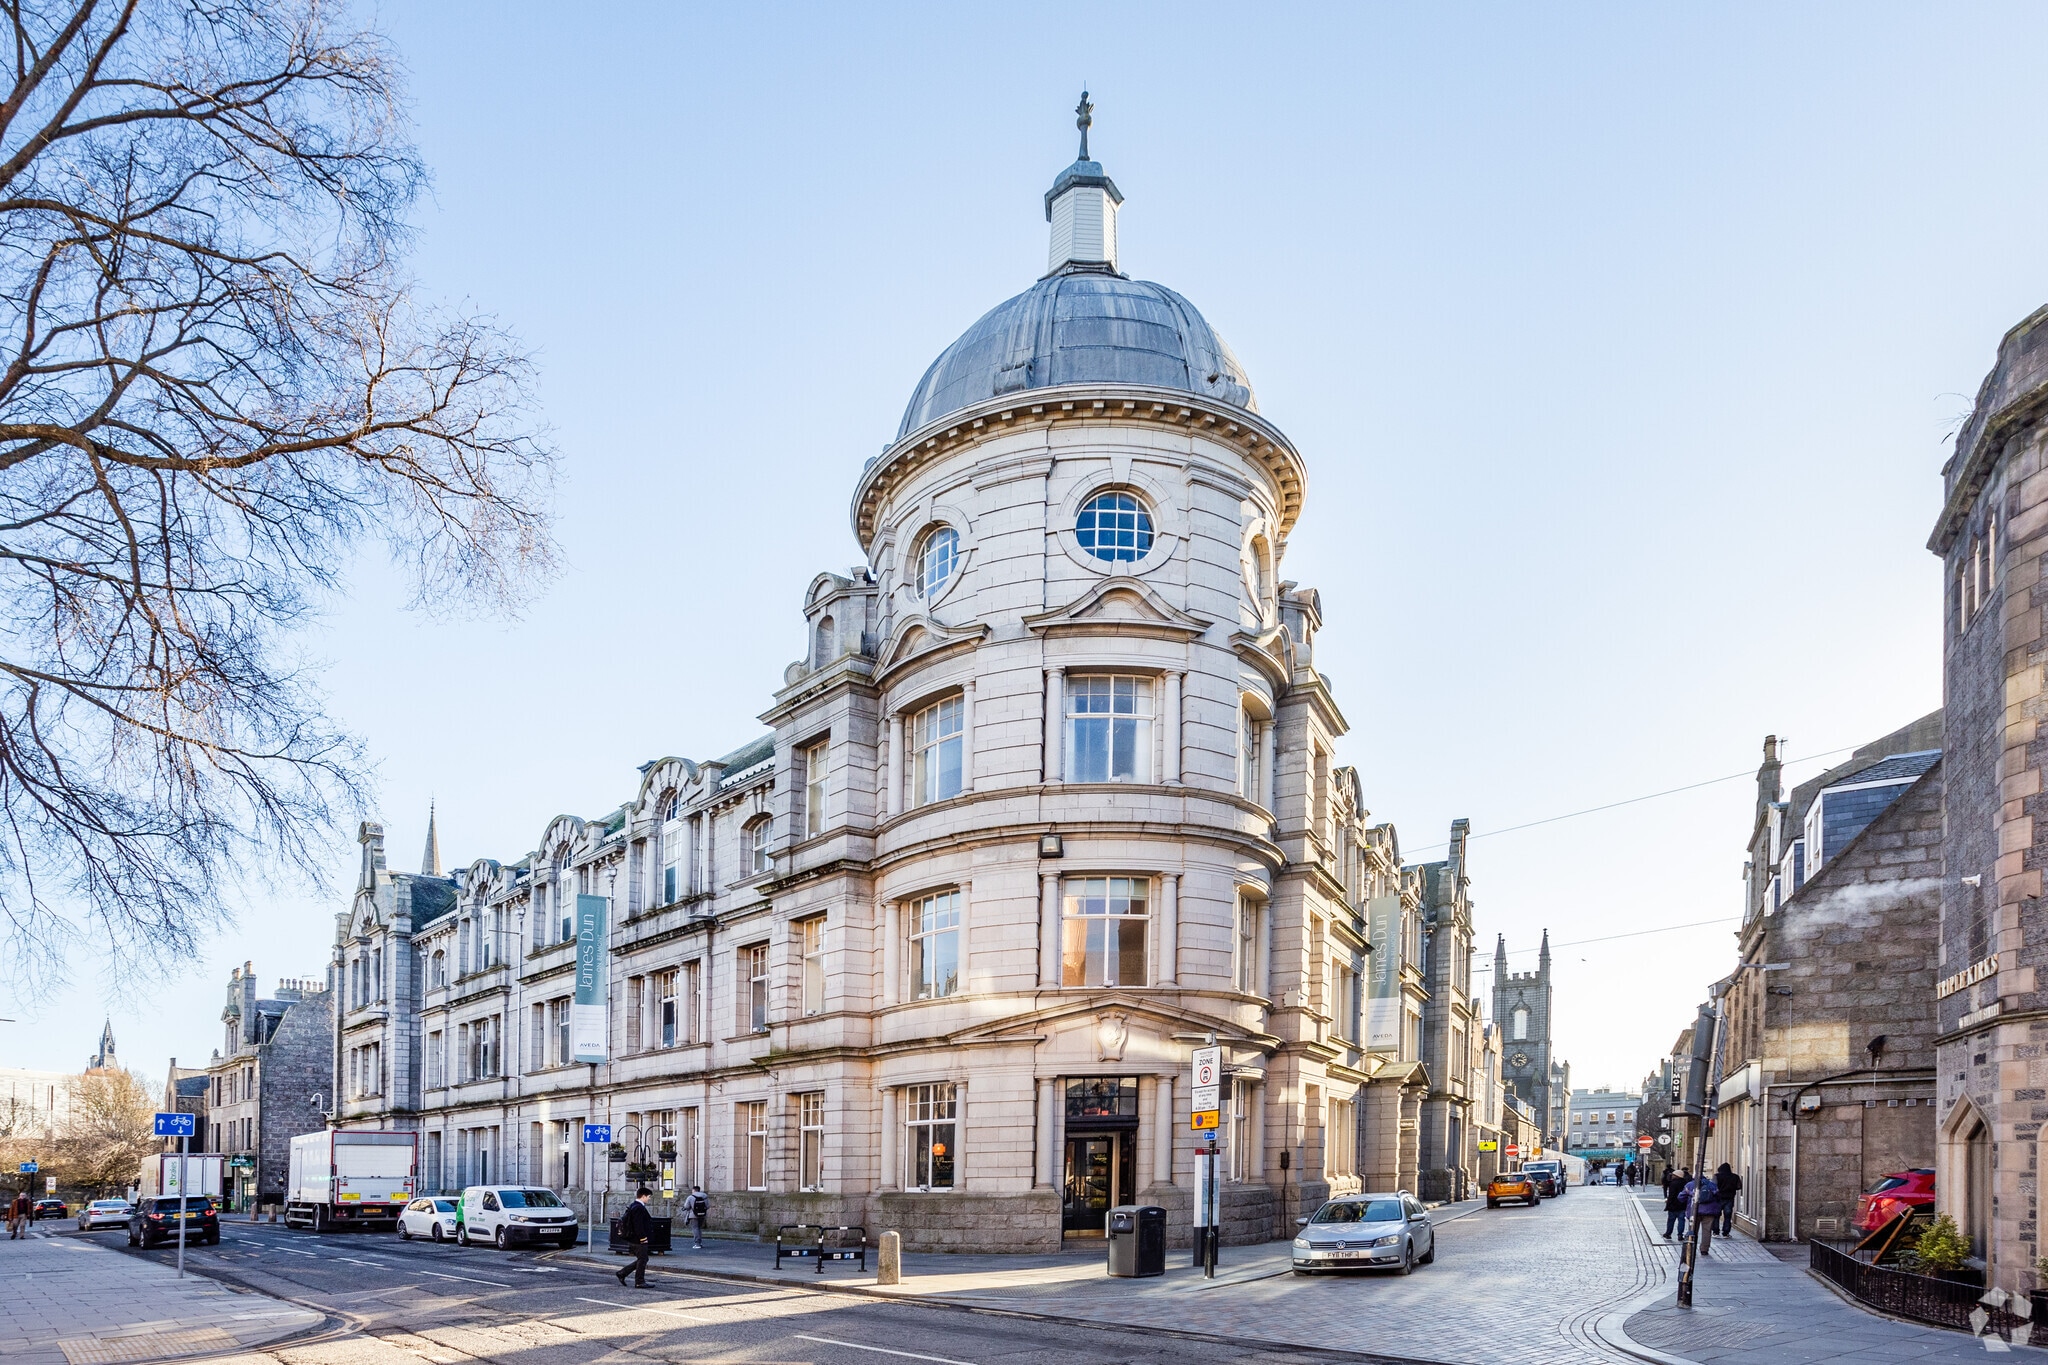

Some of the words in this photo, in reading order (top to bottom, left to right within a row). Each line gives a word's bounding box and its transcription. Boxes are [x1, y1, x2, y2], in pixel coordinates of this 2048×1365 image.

[580, 914, 594, 941] Dun
[1373, 914, 1388, 940] Dun
[579, 945, 594, 992] James
[1372, 942, 1387, 986] James
[1199, 1057, 1213, 1066] ZONE
